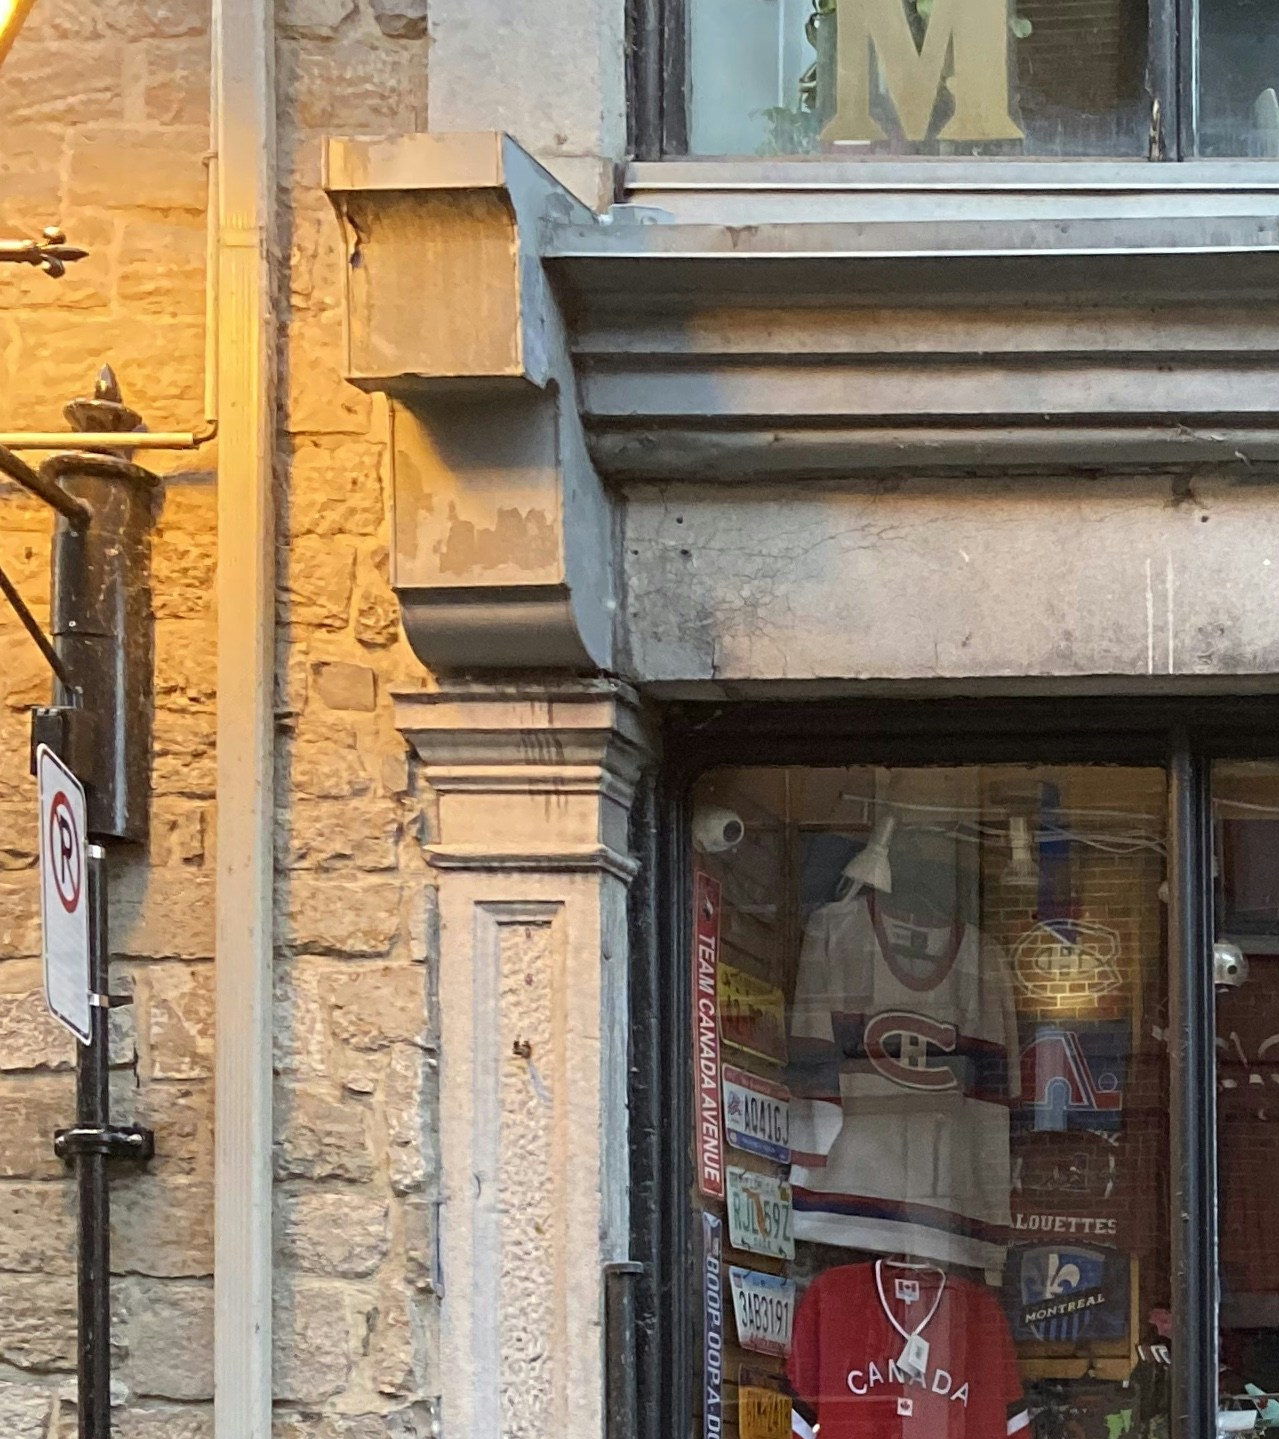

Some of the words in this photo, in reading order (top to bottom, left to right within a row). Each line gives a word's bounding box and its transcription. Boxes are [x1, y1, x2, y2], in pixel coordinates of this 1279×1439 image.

[698, 934, 716, 993] TEAM
[698, 999, 718, 1087] CANADA
[700, 1097, 720, 1184] AVENUE
[1025, 1293, 1105, 1324] MONTREAL
[847, 1357, 970, 1407] CANADA
